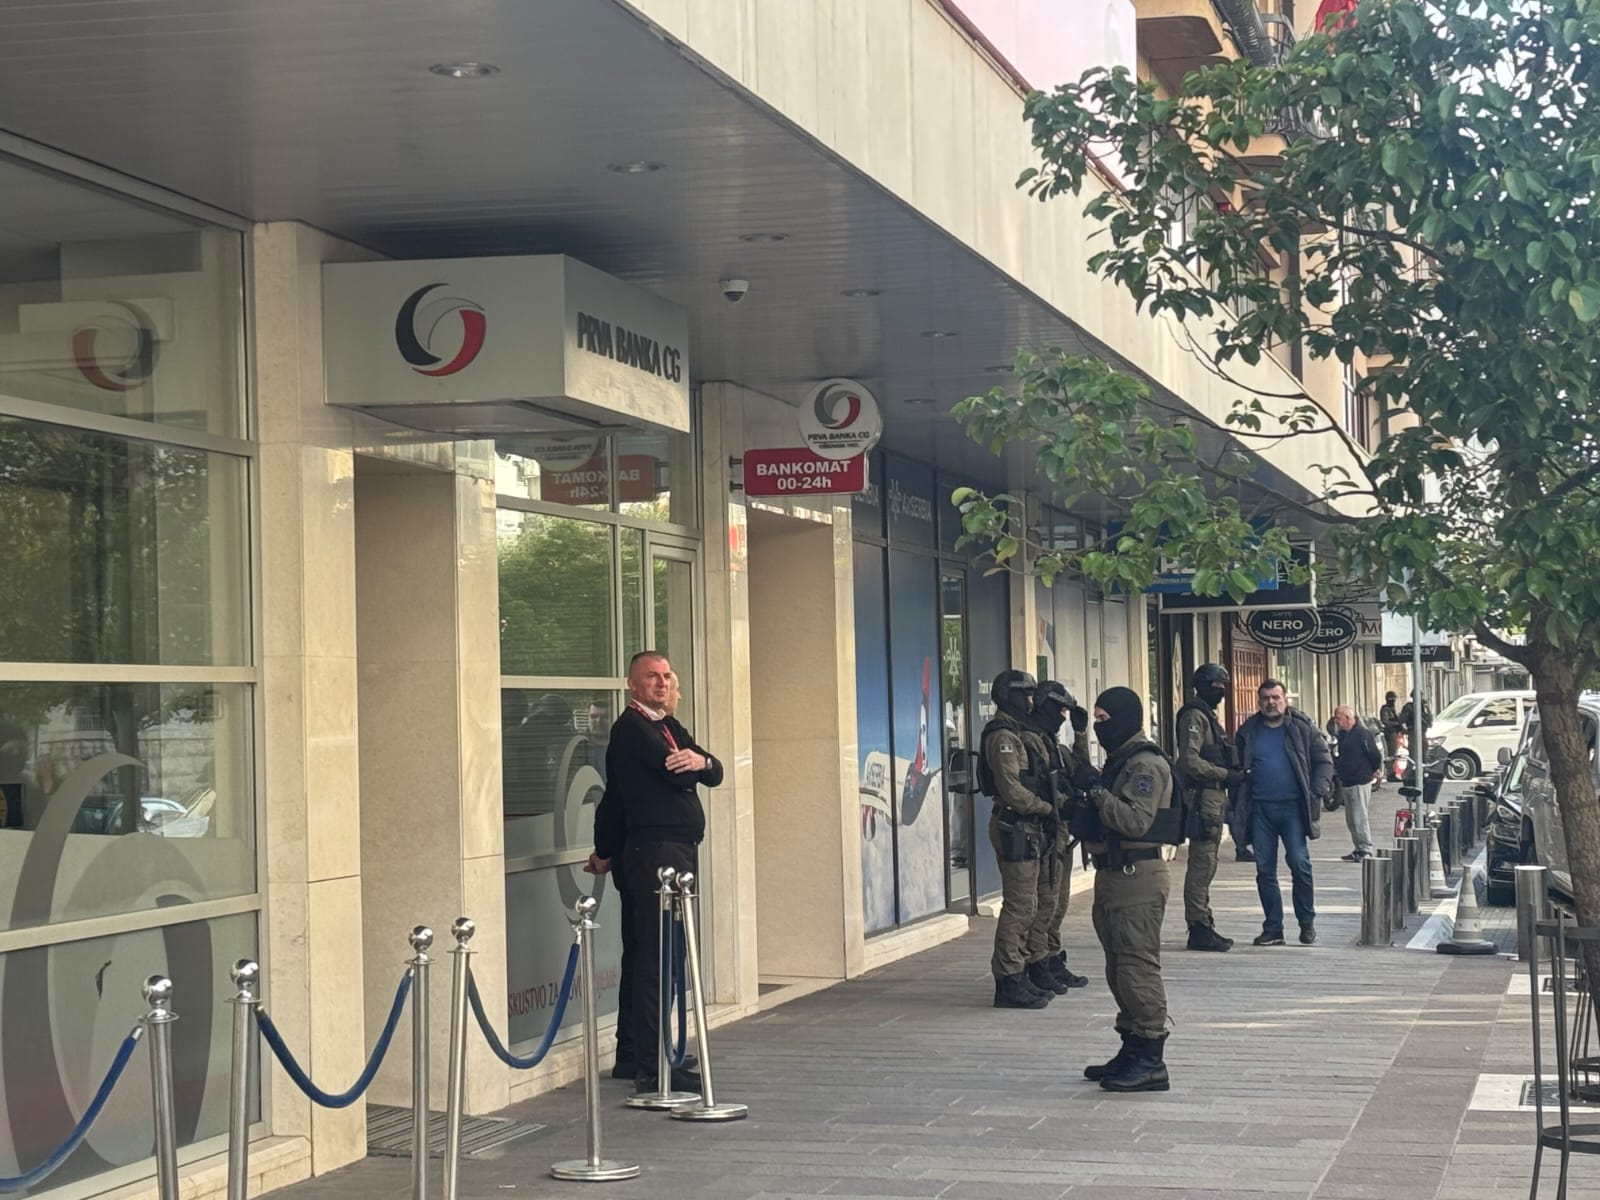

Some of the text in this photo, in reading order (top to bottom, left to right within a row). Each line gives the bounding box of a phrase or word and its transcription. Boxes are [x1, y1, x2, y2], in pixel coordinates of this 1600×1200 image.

[577, 311, 681, 383] PRVA BANKA CG
[829, 432, 857, 440] BANKA
[858, 431, 870, 439] CG
[756, 461, 851, 476] BANKOMAT
[777, 476, 832, 490] 00-24h
[1262, 620, 1304, 630] NERO
[1317, 627, 1344, 637] ERO
